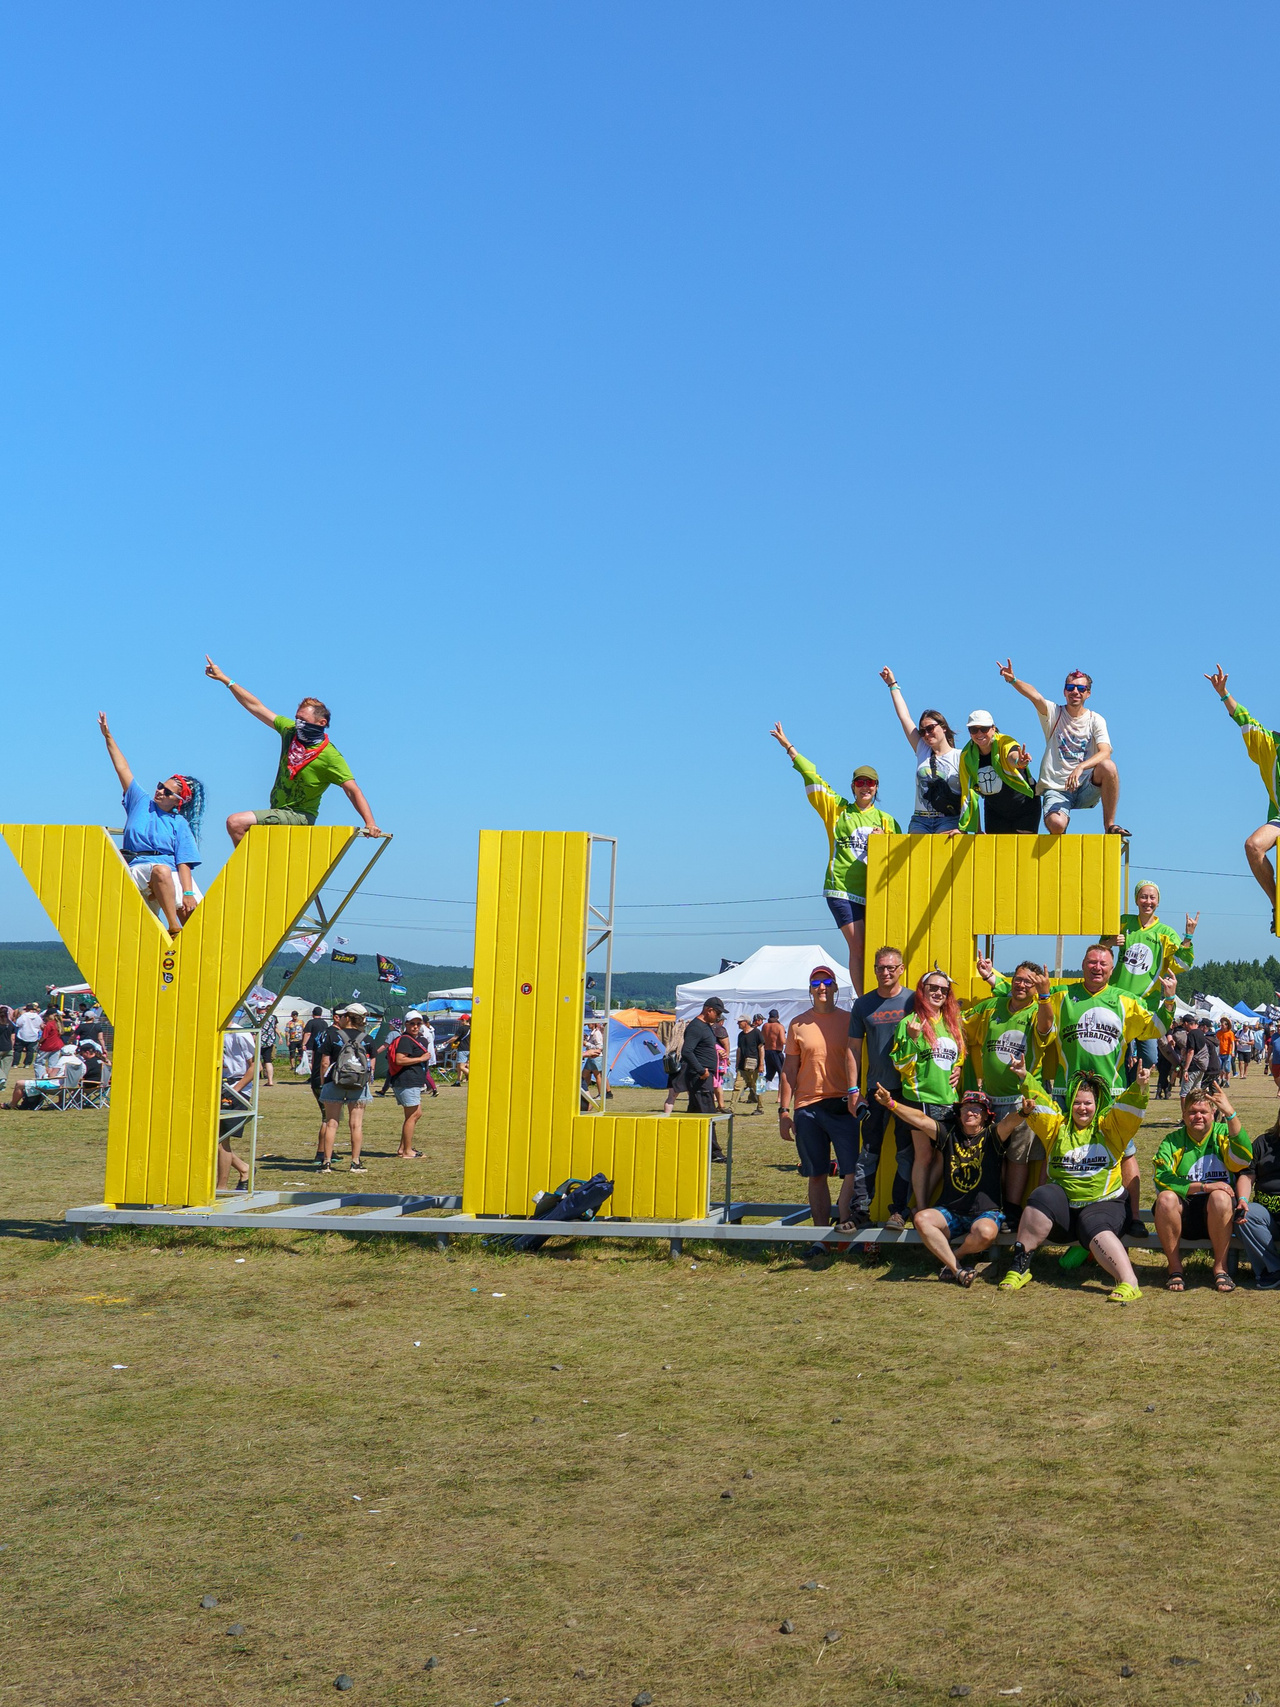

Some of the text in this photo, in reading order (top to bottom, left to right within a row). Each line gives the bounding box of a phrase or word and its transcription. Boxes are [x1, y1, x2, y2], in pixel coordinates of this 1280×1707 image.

[1062, 1022, 1120, 1035] ФОРУМ НАШИХ
[1067, 1032, 1113, 1044] ФЕСТИВАЛЕЙ
